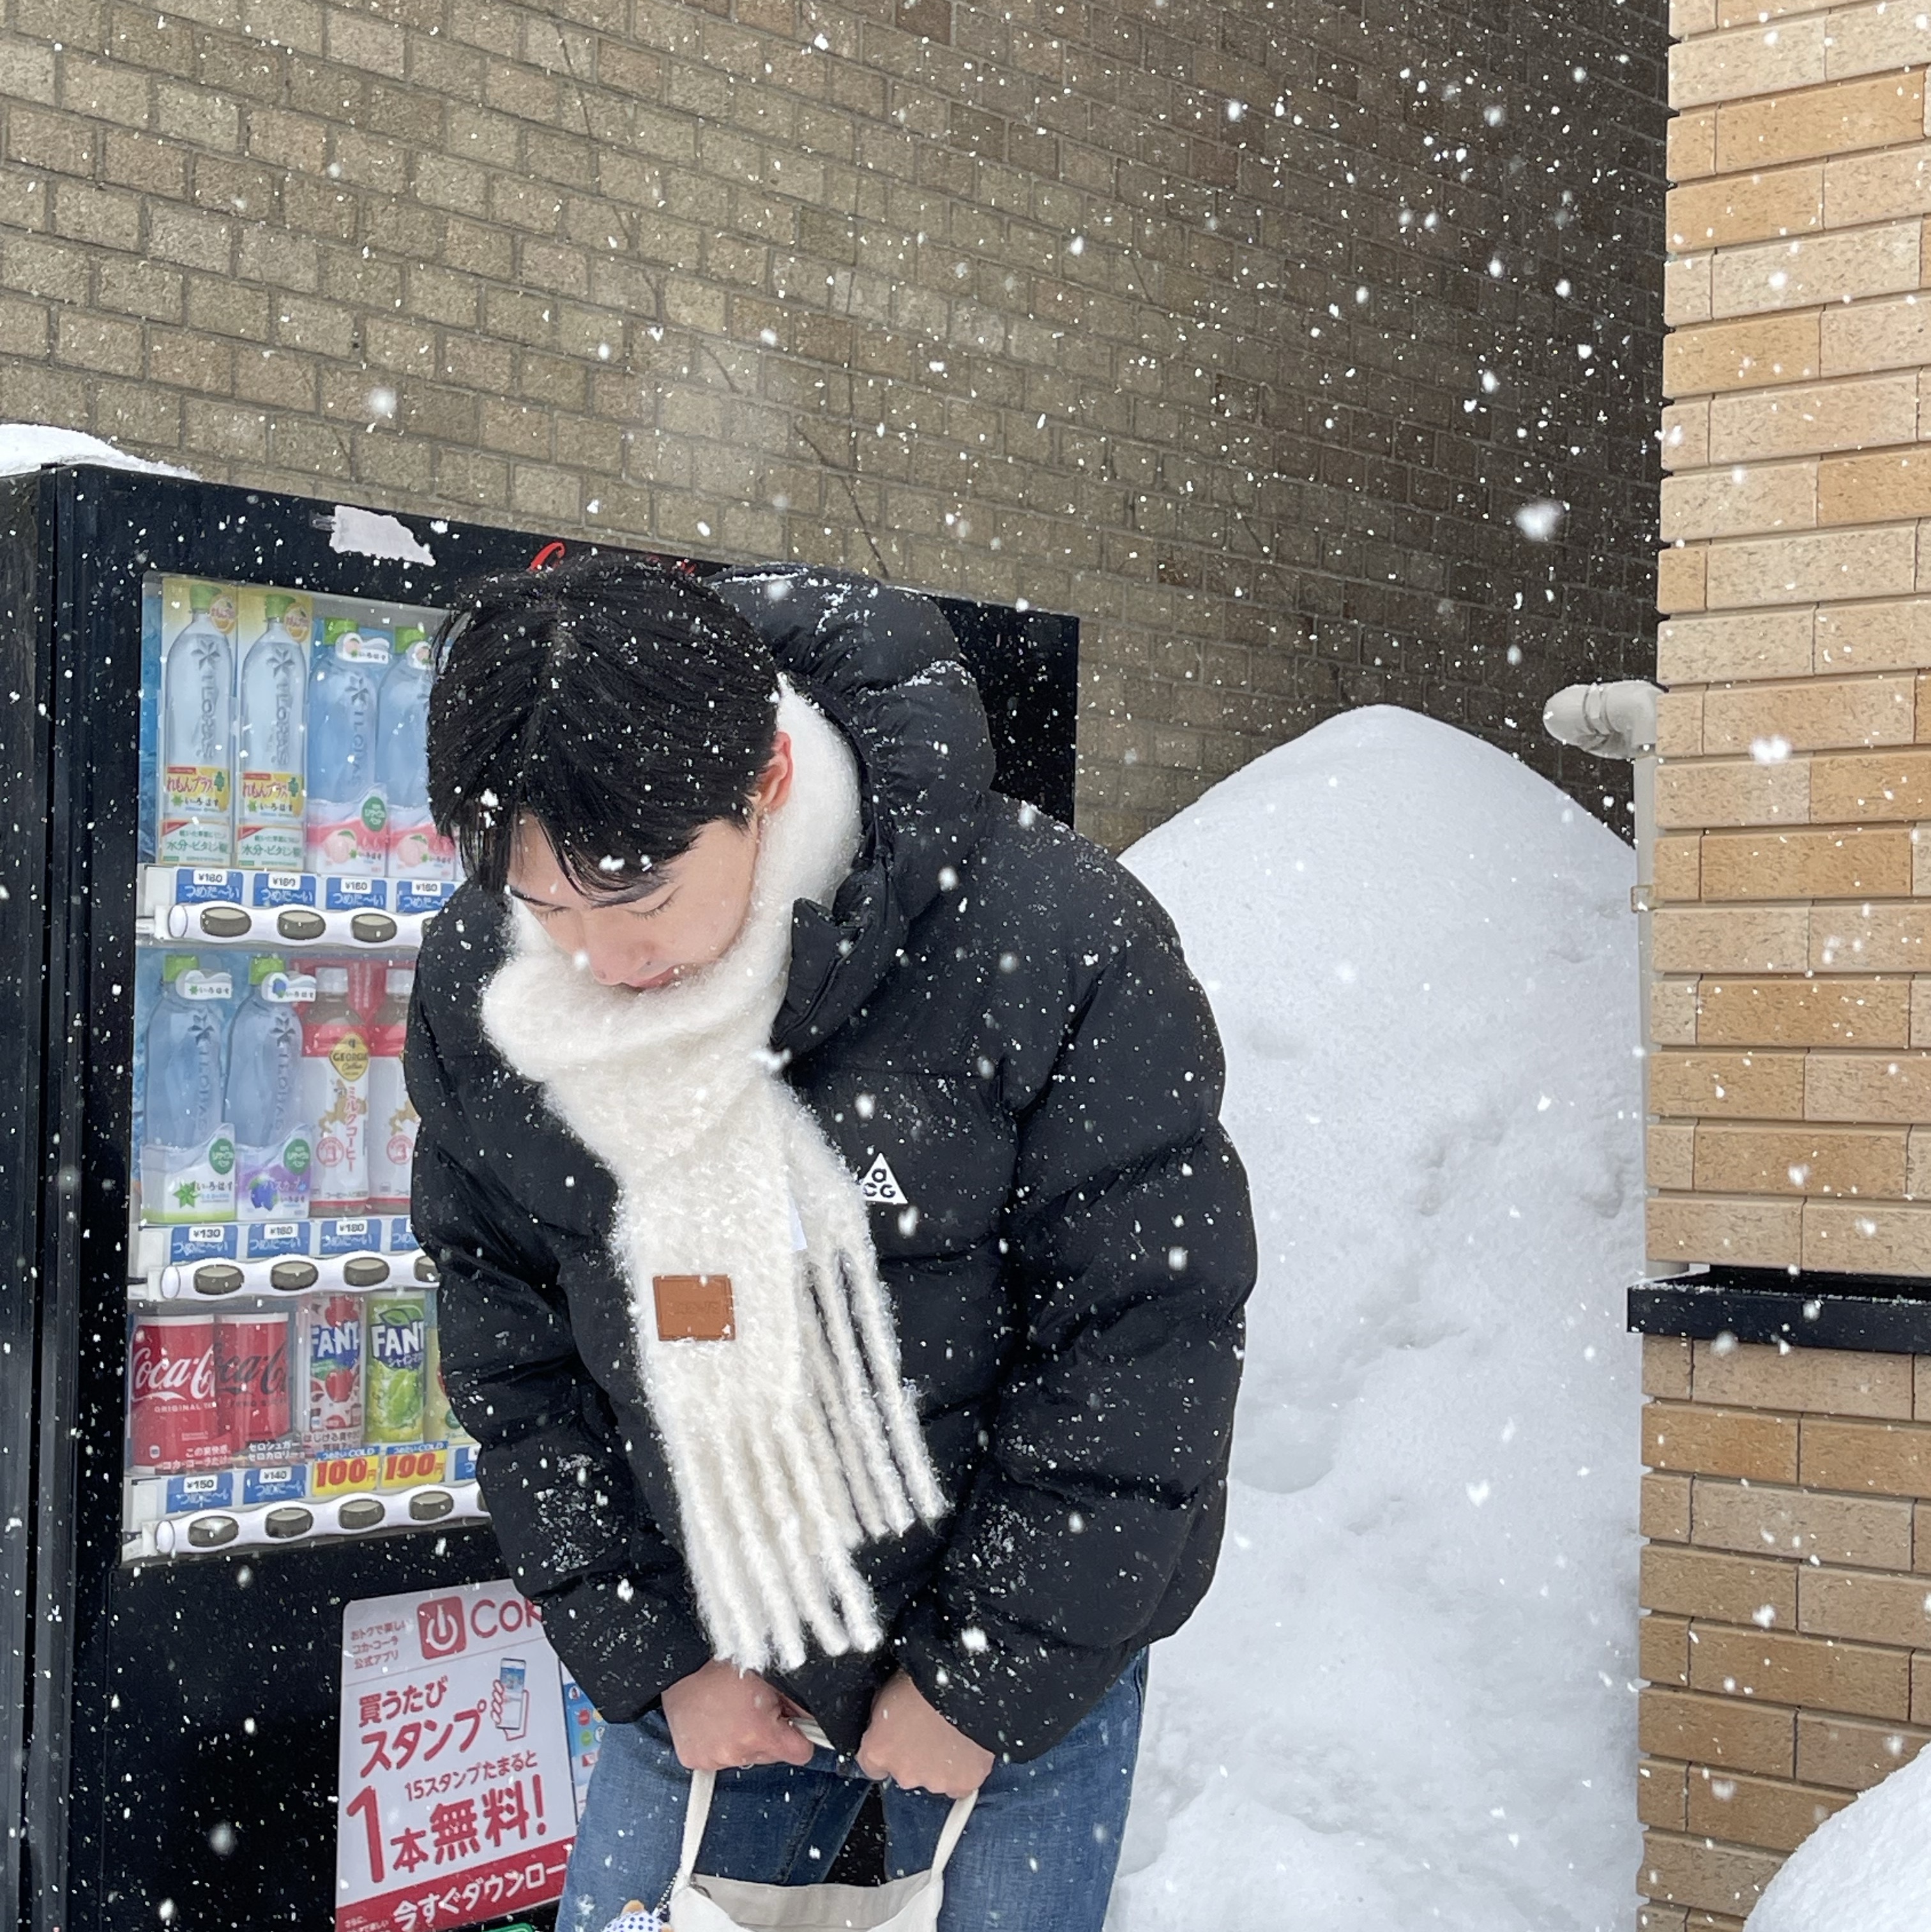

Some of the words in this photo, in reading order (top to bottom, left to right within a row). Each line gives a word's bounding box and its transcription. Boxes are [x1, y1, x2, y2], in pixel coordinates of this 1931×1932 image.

[345, 1086, 358, 1172] ミルクコーヒー
[193, 1228, 221, 1238] ¥130
[154, 1404, 201, 1413] ORIGINAL
[349, 1447, 375, 1457] COLD
[418, 1441, 444, 1452] COLD
[186, 1479, 214, 1489] ¥150
[352, 1635, 399, 1655] コカ・コーラ
[354, 1649, 399, 1670] 公式アプリ
[358, 1675, 448, 1728] 買うたび
[360, 1699, 487, 1778] スタンプ
[404, 1750, 538, 1802] 15スタンプたまると
